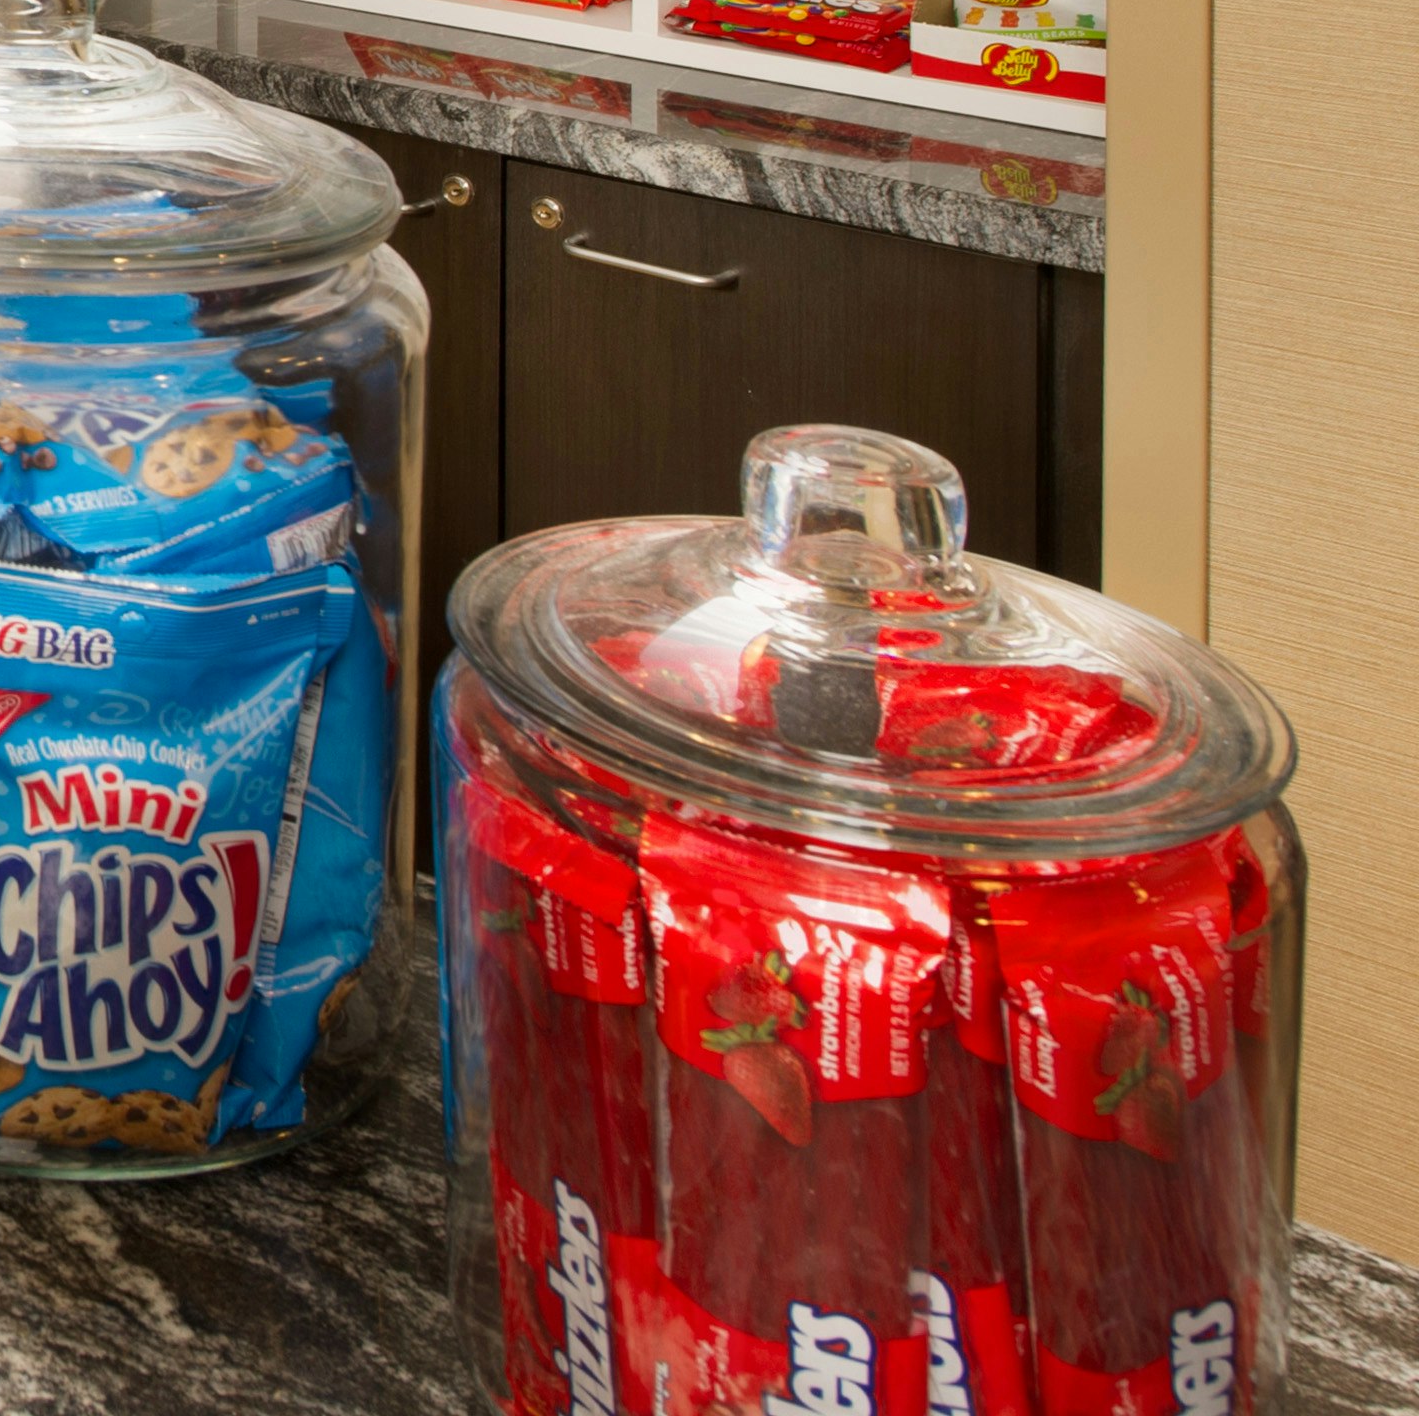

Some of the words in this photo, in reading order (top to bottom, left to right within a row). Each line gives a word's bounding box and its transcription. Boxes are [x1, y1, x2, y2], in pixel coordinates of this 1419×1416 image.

[992, 60, 1032, 84] Belly
[1004, 45, 1039, 70] Jelly
[54, 494, 66, 513] 3
[67, 486, 138, 514] SERVINGS
[35, 625, 114, 667] BAG
[5, 740, 37, 768] Real
[38, 735, 109, 760] Chocolate
[110, 735, 147, 764] Chip
[149, 743, 208, 771] Cookies
[20, 769, 208, 843] Mini
